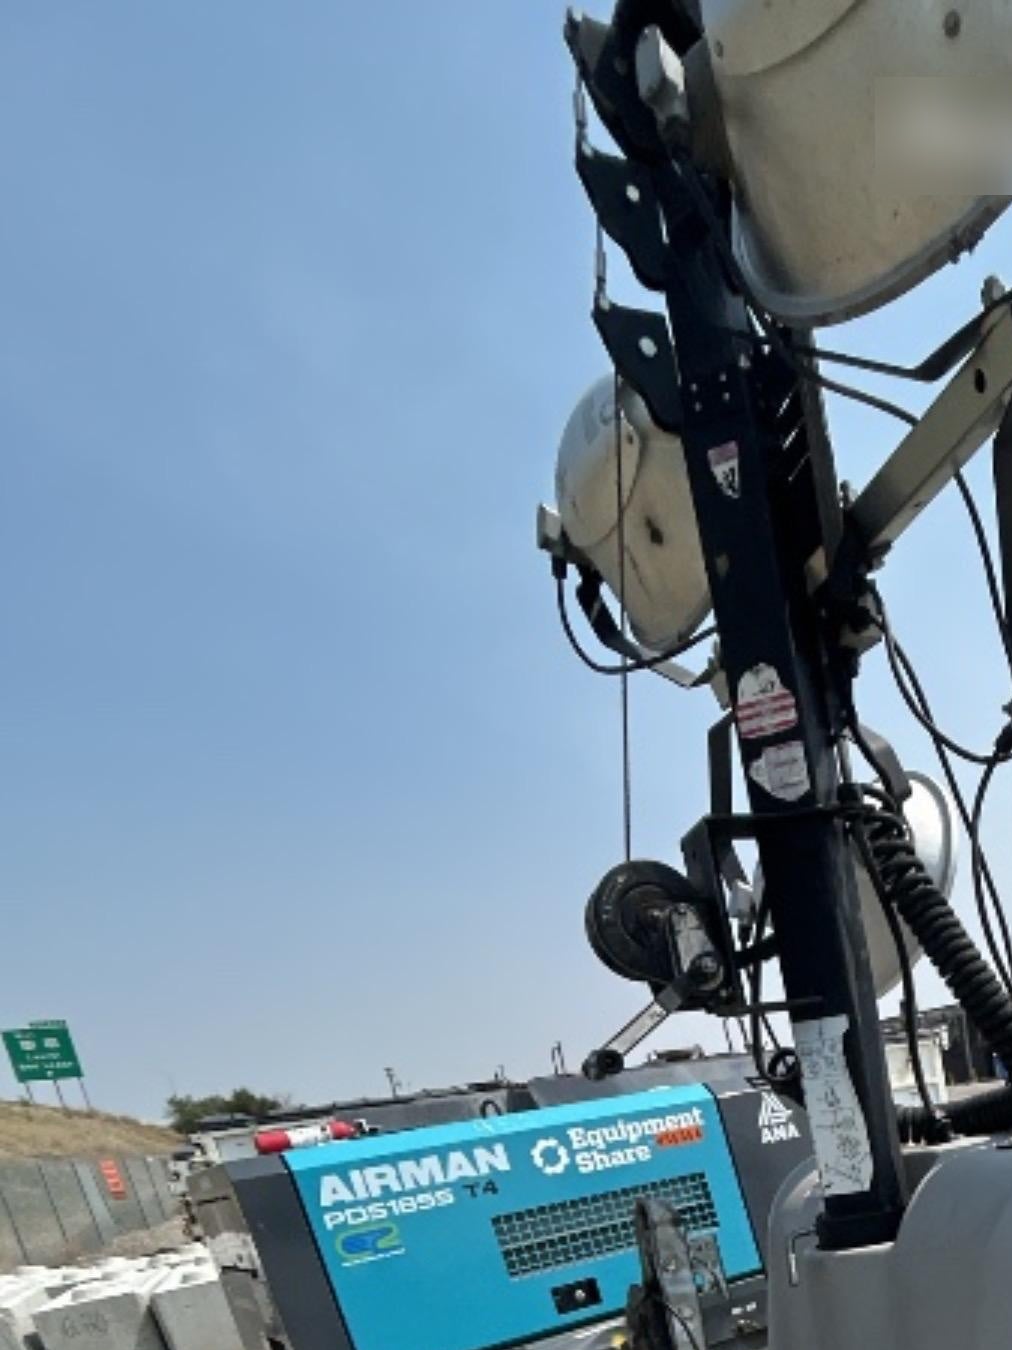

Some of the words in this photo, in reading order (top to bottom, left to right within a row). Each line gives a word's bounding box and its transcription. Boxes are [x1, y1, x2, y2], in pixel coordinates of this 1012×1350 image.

[567, 1106, 704, 1150] Equipment
[320, 1143, 511, 1207] AIRMAN
[575, 1145, 652, 1174] Share
